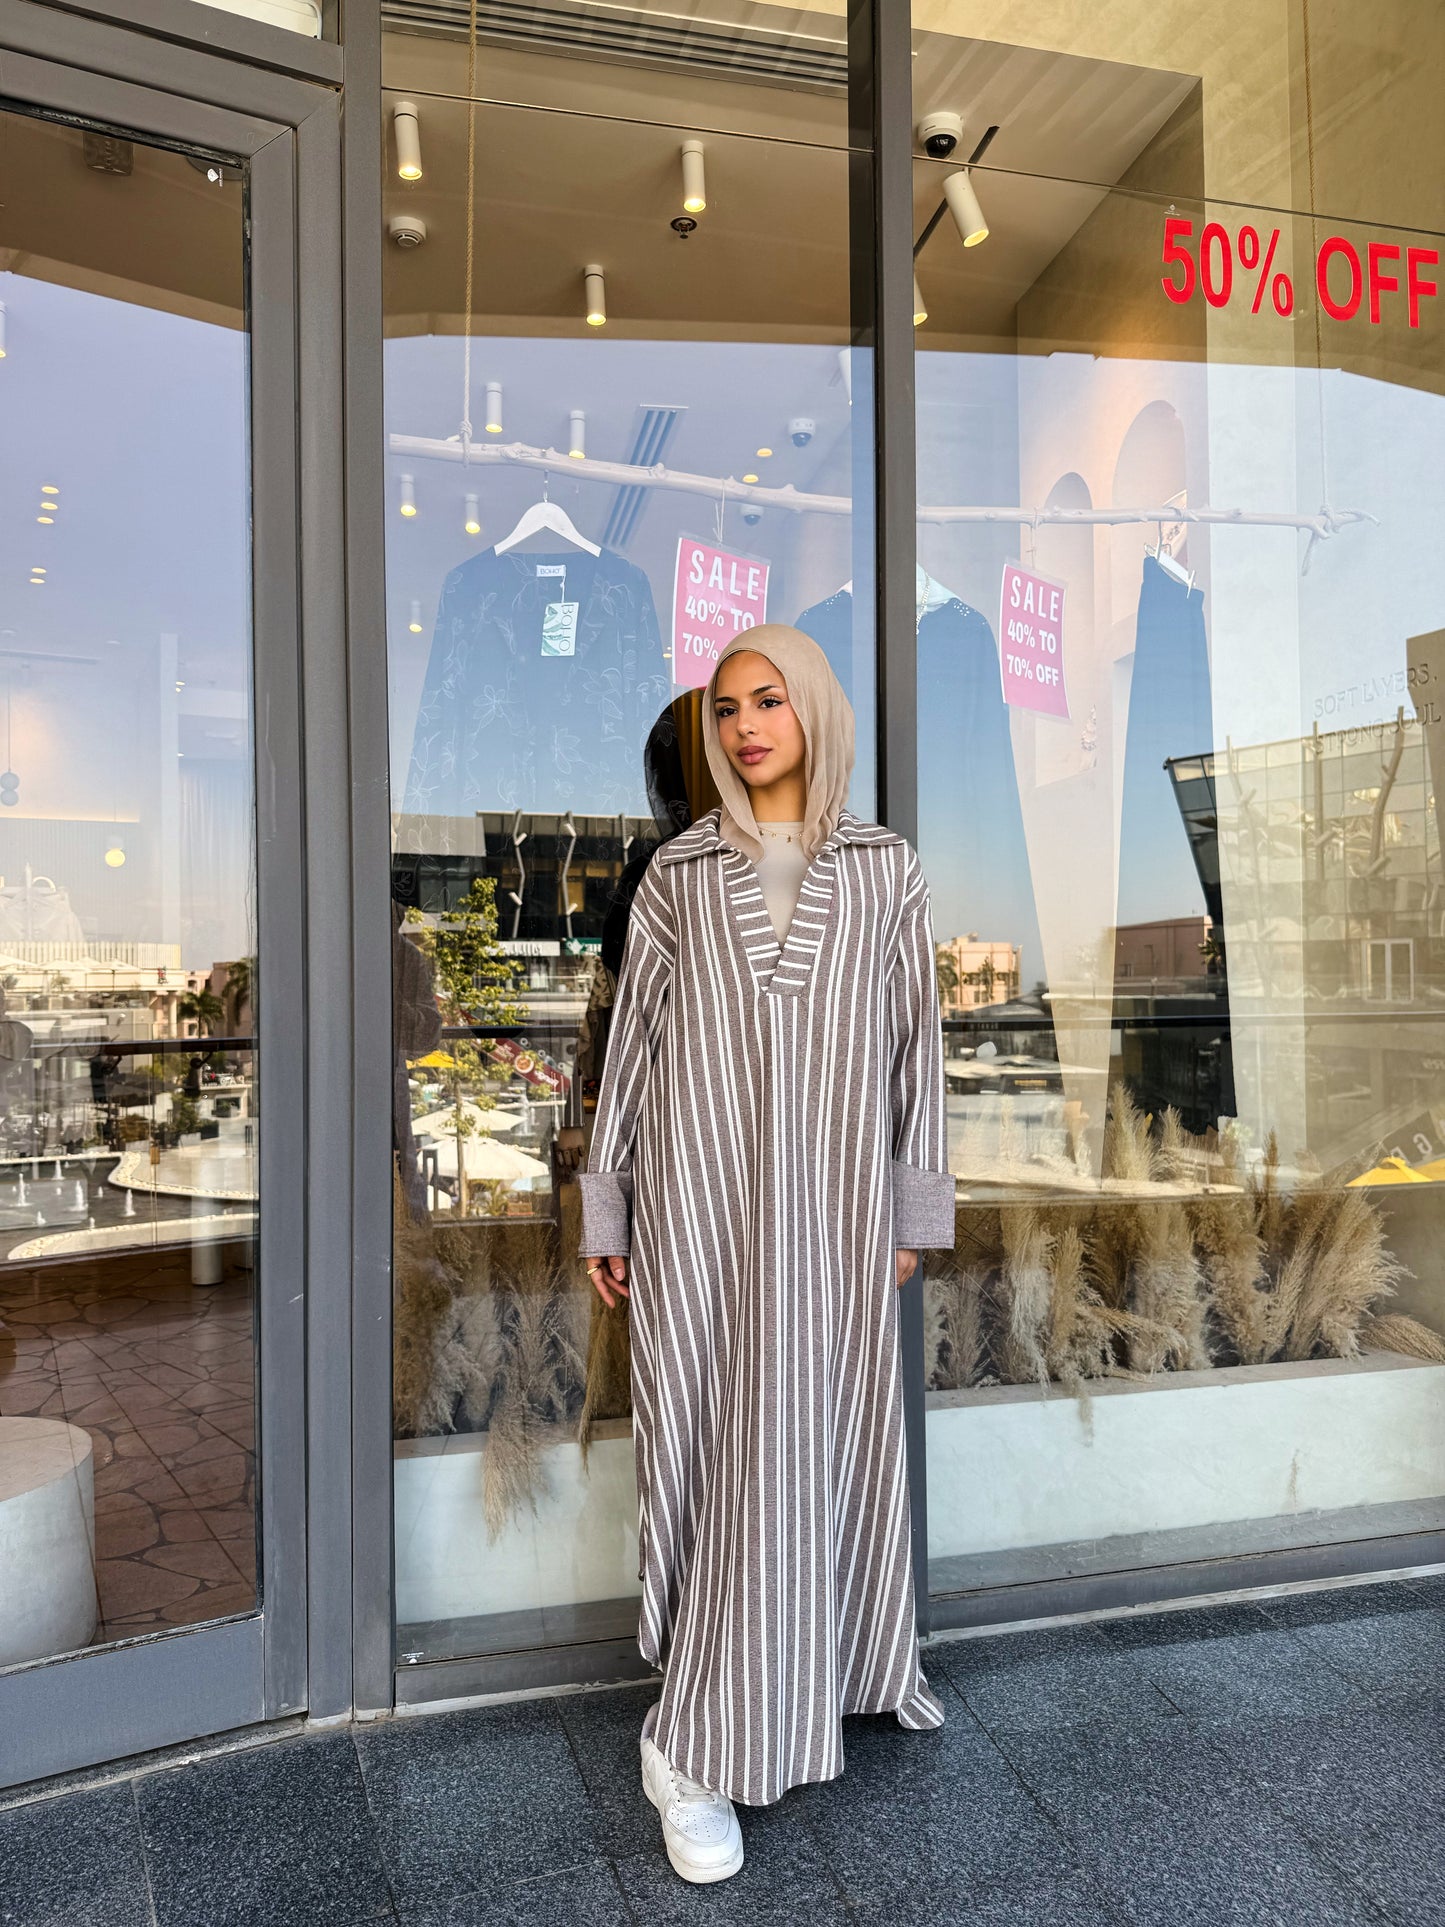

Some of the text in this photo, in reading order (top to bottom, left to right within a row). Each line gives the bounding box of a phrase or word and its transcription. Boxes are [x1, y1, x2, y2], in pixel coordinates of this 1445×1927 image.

[1161, 217, 1439, 329] 50% OFF
[689, 549, 761, 601] SALE
[684, 594, 756, 632] 40% TO
[1010, 575, 1060, 623] SALE
[558, 603, 575, 652] BOHO
[682, 632, 719, 661] 70%
[1007, 618, 1057, 655] 40% TO
[1006, 653, 1060, 687] 70% OFF
[1313, 686, 1358, 718] SOFT
